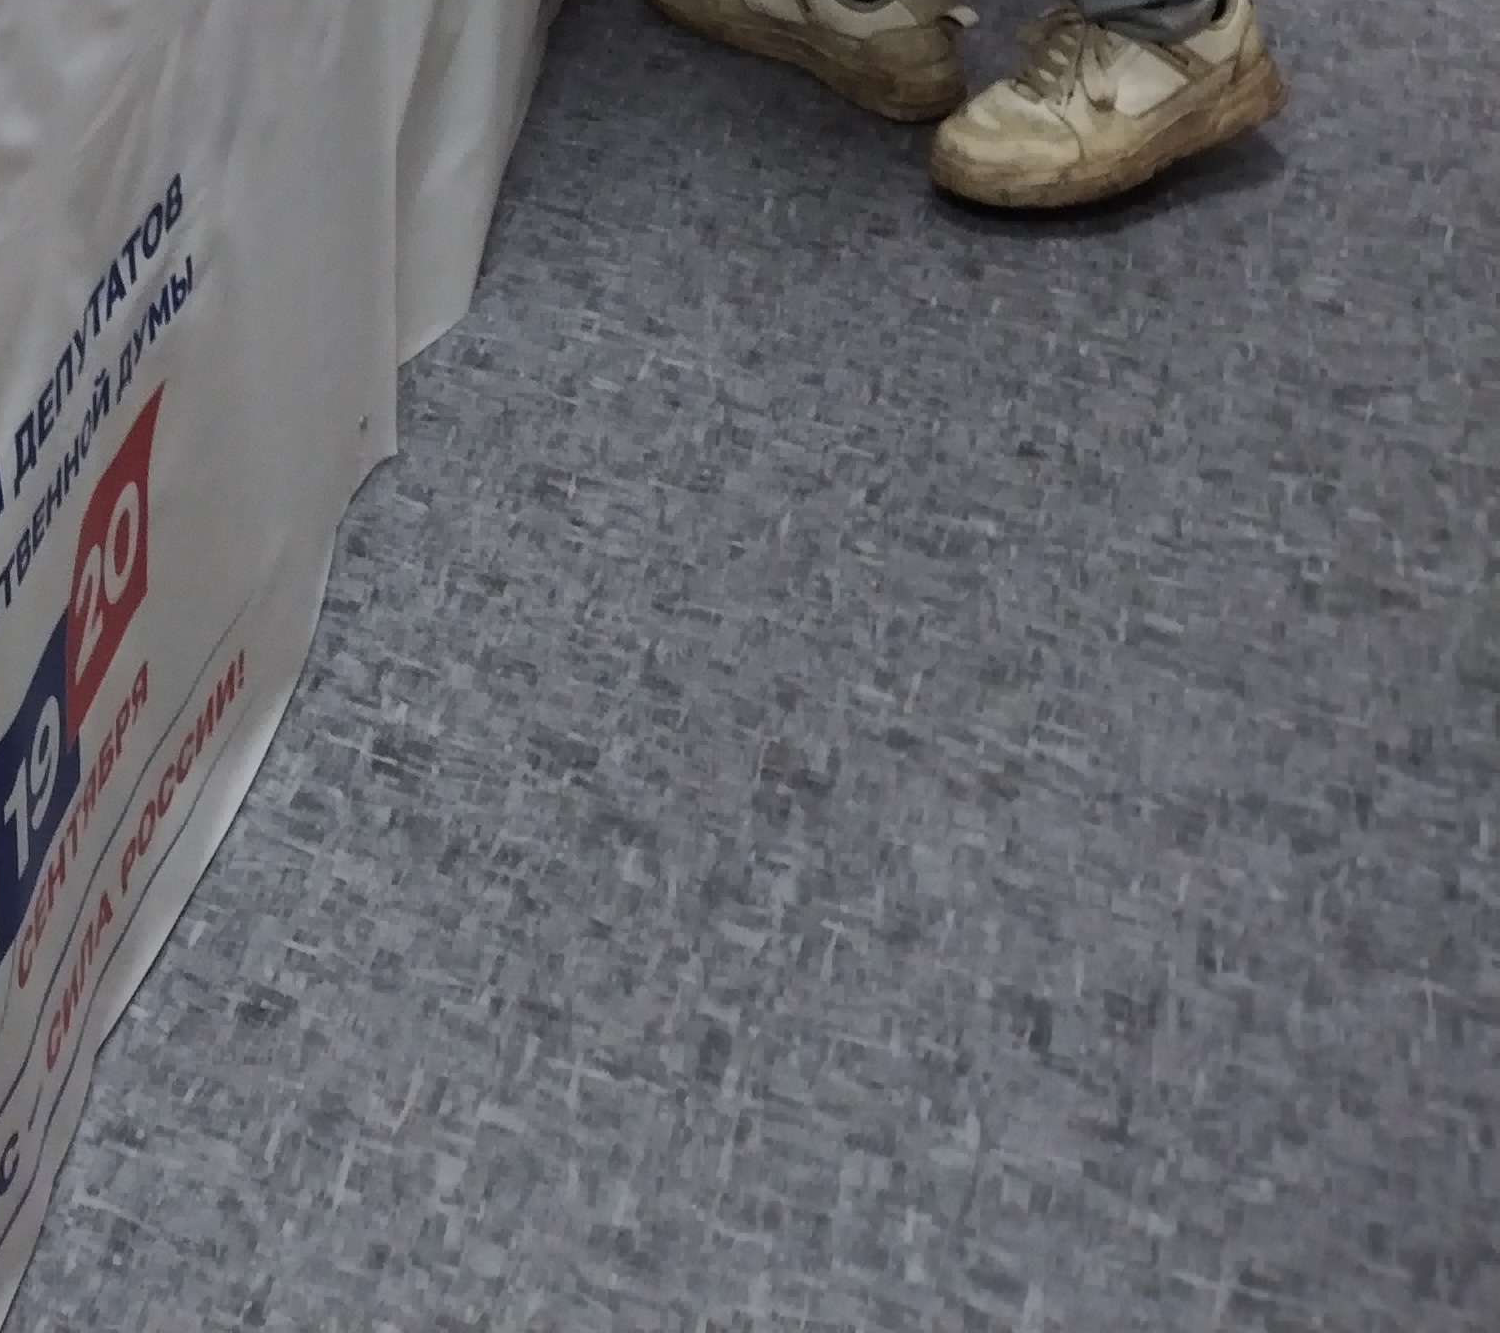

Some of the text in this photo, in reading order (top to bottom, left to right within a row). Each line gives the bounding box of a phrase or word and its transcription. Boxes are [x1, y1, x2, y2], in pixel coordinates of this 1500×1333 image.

[14, 173, 183, 499] ДЕПУТАТОВ
[116, 254, 193, 405] ДУМЫ
[75, 481, 139, 687] 20
[3, 695, 61, 882] 19
[17, 661, 148, 989] СЕНТЯБРЯ
[46, 889, 113, 1073] СИЛА
[121, 648, 245, 896] РОССИИ!
